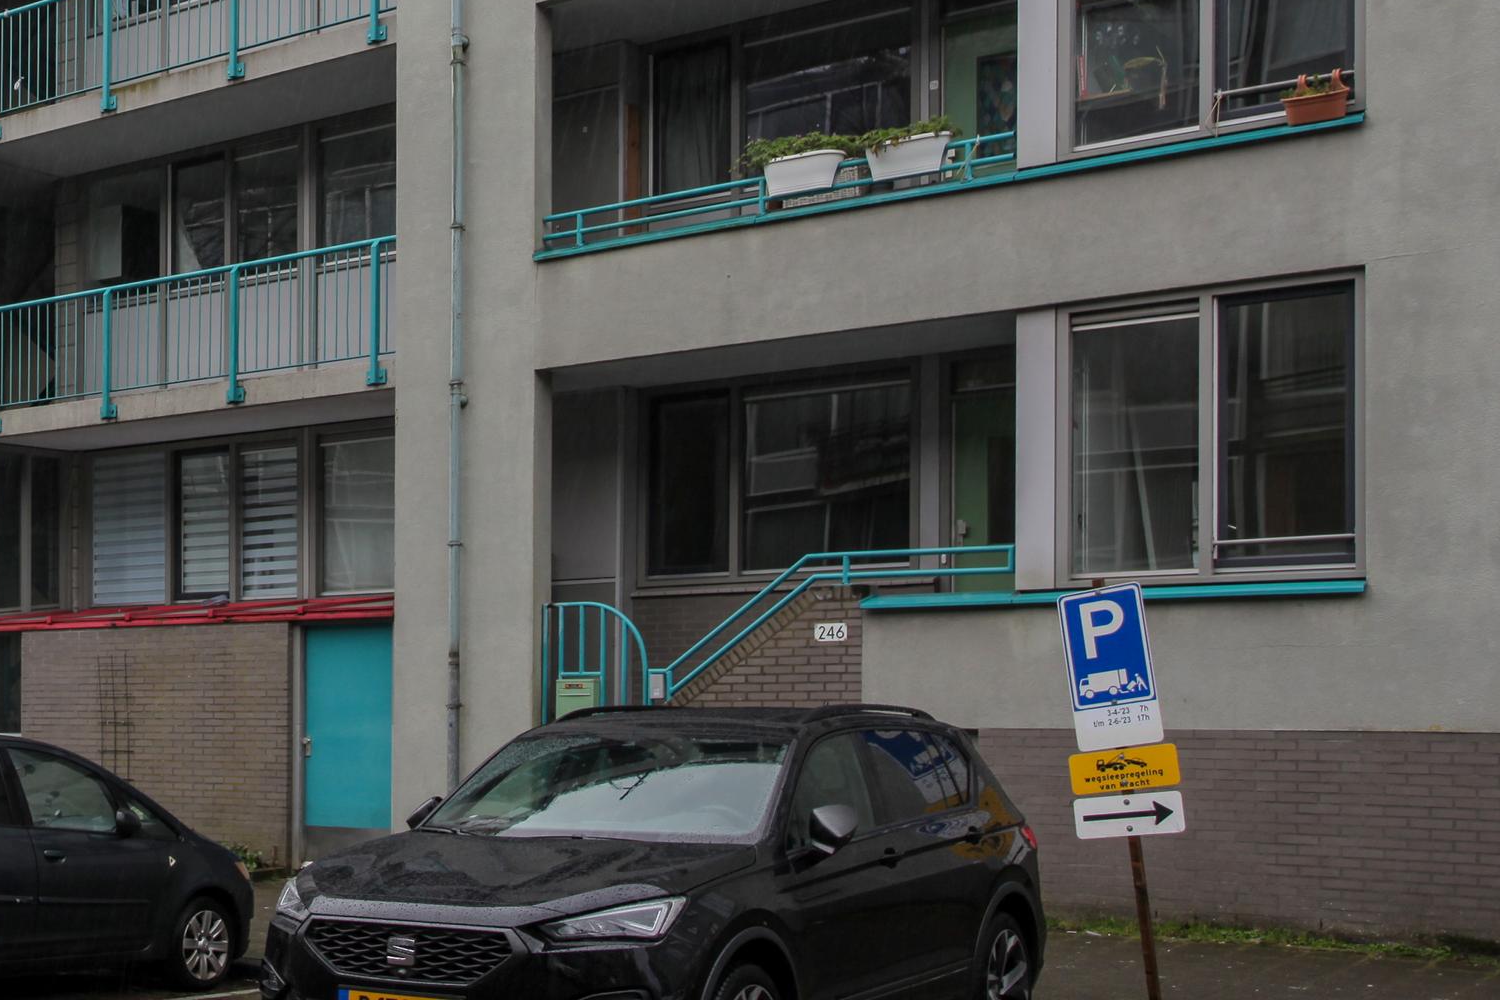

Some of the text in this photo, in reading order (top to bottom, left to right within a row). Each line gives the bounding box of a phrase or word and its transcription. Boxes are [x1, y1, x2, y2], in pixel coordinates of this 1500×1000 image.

[818, 625, 845, 640] 246
[1079, 600, 1124, 660] P
[1084, 769, 1164, 783] wegsleepregeling
